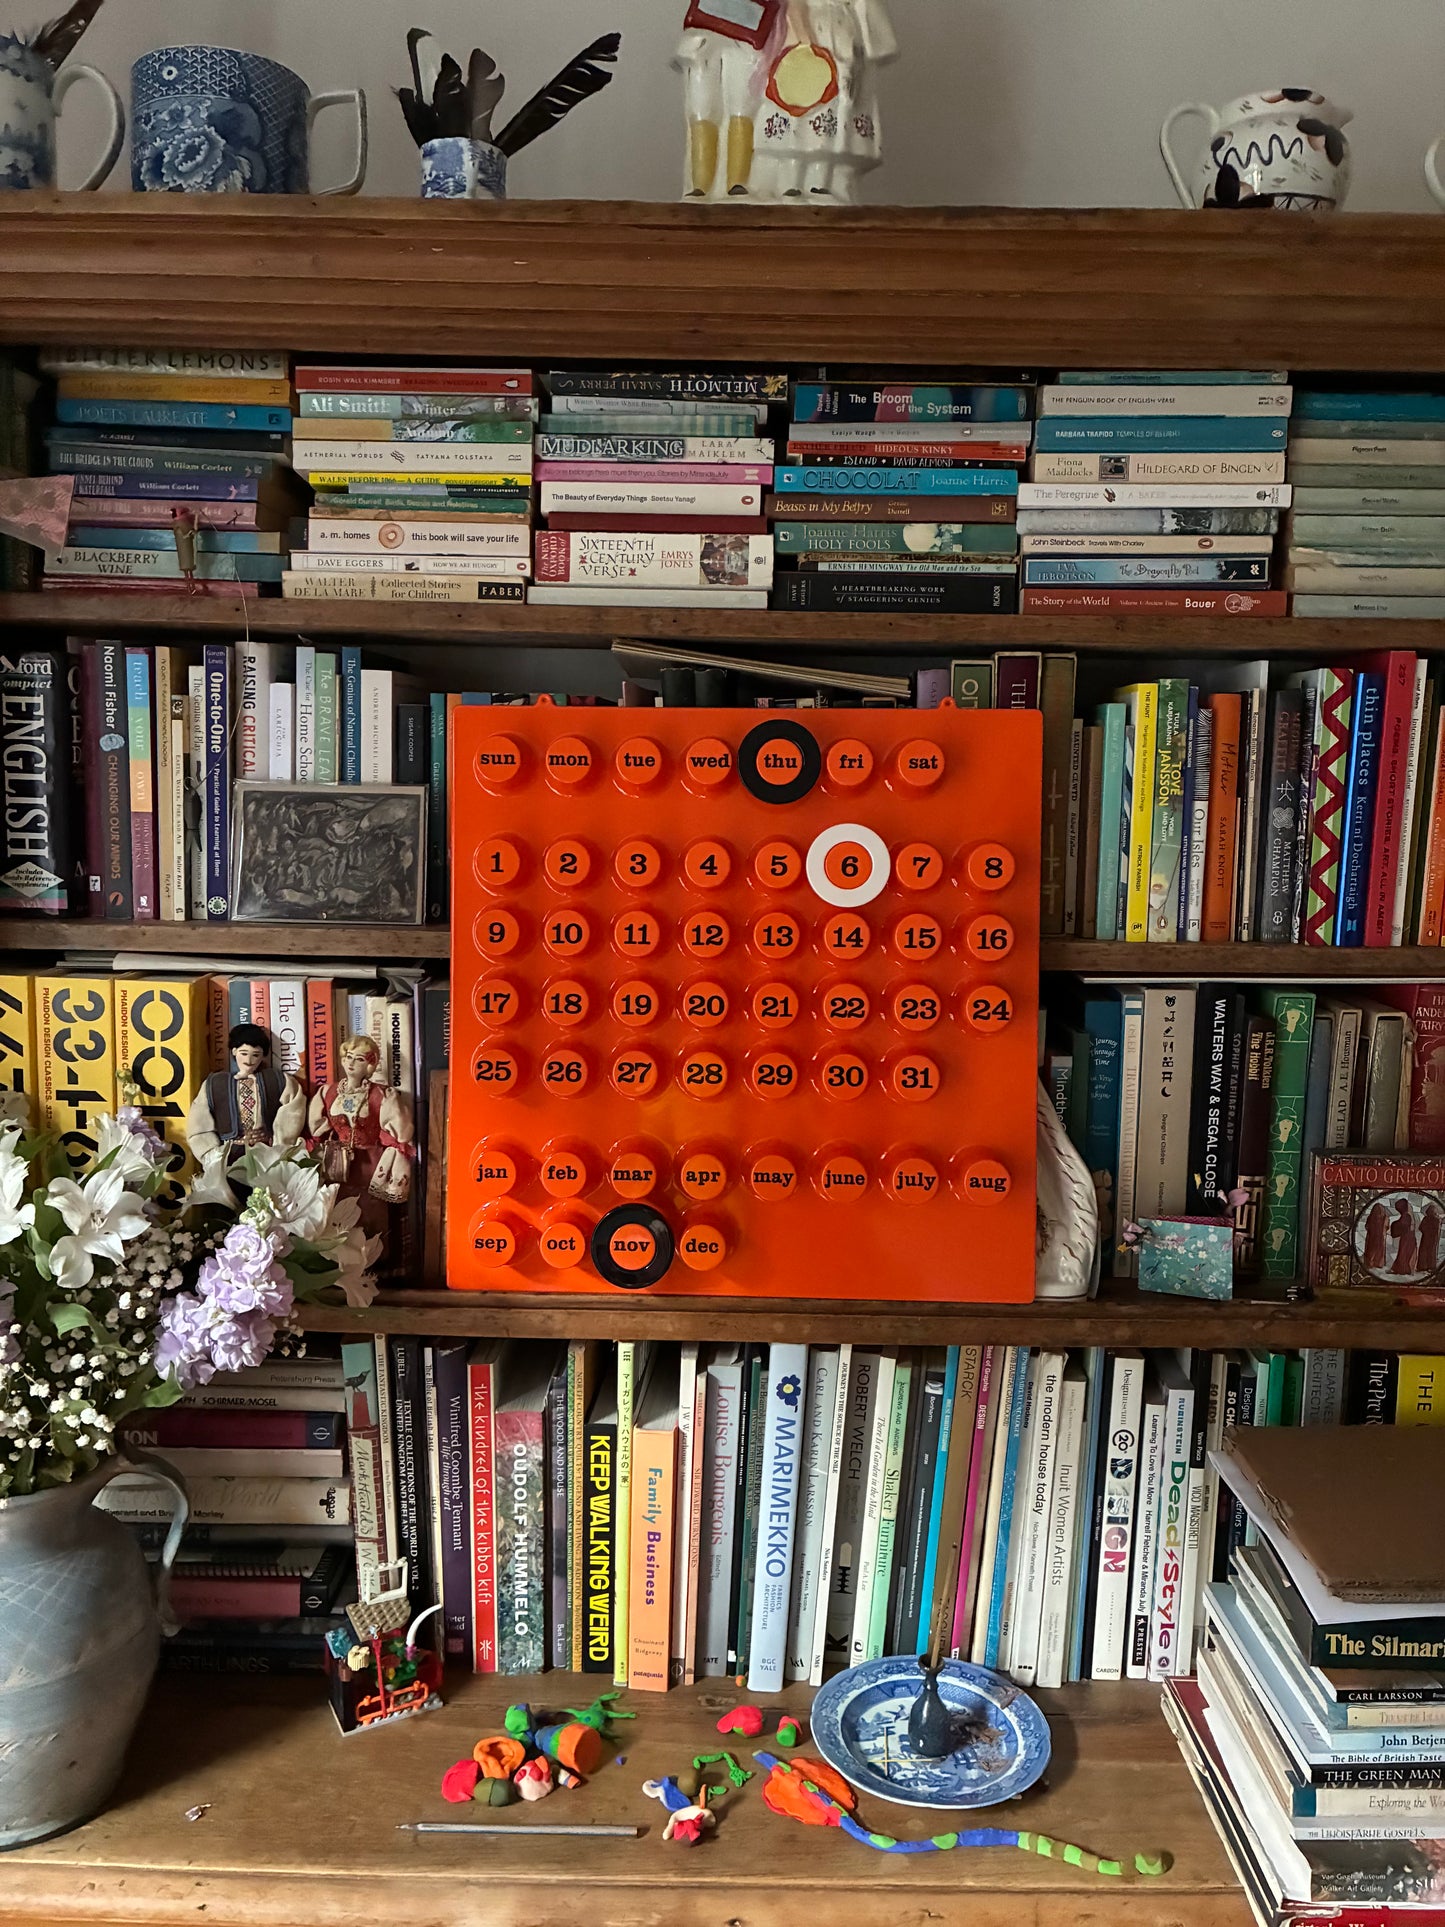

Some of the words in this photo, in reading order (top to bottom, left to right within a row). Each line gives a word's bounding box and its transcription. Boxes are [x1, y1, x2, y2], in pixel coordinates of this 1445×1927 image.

[168, 354, 270, 370] LEMONS
[670, 380, 758, 393] MELMOTH
[850, 394, 867, 404] The
[873, 392, 913, 404] Broom
[310, 398, 333, 412] Ali
[339, 398, 392, 413] Smith
[896, 403, 905, 413] of
[908, 404, 923, 413] the
[927, 403, 972, 416] System
[542, 436, 684, 456] MUDLARKING
[803, 470, 920, 490] CHOCOLAT
[932, 474, 969, 487] Joanne
[973, 475, 1009, 486] Harris
[1136, 464, 1199, 474] HILDEGARD
[1203, 464, 1218, 474] OF
[1220, 464, 1261, 474] BINGEN
[564, 494, 587, 502] Beauty
[343, 531, 370, 539] homes
[429, 533, 448, 541] book
[450, 533, 464, 541] will
[486, 536, 504, 544] your
[506, 534, 519, 543] life
[579, 536, 654, 551] SIXTEENTH
[74, 552, 159, 564] BLACKBERRY
[98, 564, 132, 574] WINE
[317, 559, 341, 567] DAVE
[345, 559, 384, 567] EGGERS
[590, 552, 654, 567] CENTURY
[660, 551, 693, 560] EMRYS
[660, 560, 693, 568] JONES
[579, 566, 626, 578] VERSE
[482, 587, 522, 597] FABER
[1030, 597, 1042, 605] The
[1043, 597, 1065, 607] Story
[1082, 596, 1110, 606] World
[1185, 598, 1216, 609] Bauer
[104, 646, 116, 687] Naomi
[321, 668, 332, 687] The
[244, 656, 256, 710] RAISING
[106, 690, 116, 729] Fisher
[210, 672, 224, 754] One-to-One
[320, 696, 331, 743] BRAVE
[1364, 688, 1380, 724] thin
[300, 704, 312, 744] Home
[242, 716, 255, 775] CRITICAL
[480, 752, 516, 766] sun
[548, 754, 590, 767] mon
[624, 752, 655, 767] tue
[690, 753, 730, 768] wed
[763, 753, 798, 769] thu
[839, 755, 864, 769] fri
[909, 755, 938, 770] sat
[1358, 731, 1373, 785] places
[2, 693, 49, 859] ENGLISH
[107, 754, 119, 814] CHANGING
[1158, 749, 1171, 807] JANSSON
[1170, 761, 1182, 796] TOVE
[1221, 742, 1236, 796] Mother
[109, 817, 120, 842] OUR
[111, 844, 121, 879] MINDS
[490, 852, 504, 873] 1
[560, 853, 578, 874] 2
[630, 853, 647, 874] 3
[700, 854, 718, 875] 4
[770, 855, 788, 877] 5
[841, 856, 858, 877] 6
[913, 856, 931, 878] 7
[985, 857, 1003, 878] 8
[1217, 854, 1225, 888] KNOTT
[488, 922, 505, 943] 9
[552, 923, 583, 944] 10
[624, 924, 651, 945] 11
[691, 924, 724, 946] 12
[762, 926, 794, 947] 13
[833, 926, 864, 948] 14
[904, 928, 936, 949] 15
[977, 928, 1008, 950] 16
[279, 992, 295, 1022] The
[314, 1001, 326, 1028] ALL
[480, 992, 510, 1014] 17
[550, 993, 582, 1014] 18
[620, 994, 652, 1016] 19
[688, 995, 725, 1016] 20
[761, 996, 793, 1018] 21
[830, 997, 865, 1018] 22
[900, 998, 937, 1020] 23
[972, 999, 1010, 1020] 24
[1212, 999, 1226, 1064] WALTERS
[1254, 1032, 1263, 1049] The
[314, 1032, 327, 1072] YEAR
[392, 1013, 401, 1087] HOUSEBUILDING
[476, 1060, 512, 1081] 25
[546, 1061, 582, 1082] 26
[617, 1062, 652, 1084] 27
[686, 1064, 723, 1085] 28
[757, 1064, 793, 1086] 29
[828, 1066, 864, 1087] 30
[901, 1067, 933, 1089] 31
[1210, 1066, 1223, 1094] WAY
[1248, 1052, 1260, 1081] Hobbit
[1210, 1096, 1221, 1106] &
[1207, 1108, 1220, 1152] SEGAL
[476, 1164, 508, 1183] jan
[547, 1166, 578, 1180] feb
[613, 1170, 653, 1182] mar
[686, 1171, 720, 1186] apr
[753, 1172, 794, 1187] may
[824, 1170, 865, 1188] june
[896, 1171, 936, 1190] july
[969, 1176, 1006, 1192] aug
[1204, 1154, 1216, 1199] CLOSE
[1323, 1167, 1378, 1183] CANTO
[474, 1237, 508, 1253] sep
[547, 1237, 576, 1251] oct
[614, 1241, 650, 1253] nov
[685, 1239, 719, 1254] dec
[854, 1364, 871, 1421] ROBERT
[1046, 1374, 1057, 1393] the
[450, 1396, 461, 1447] Winifred
[716, 1385, 736, 1446] Louise
[1042, 1397, 1053, 1440] modern
[590, 1435, 611, 1491] KEEP
[848, 1426, 865, 1480] WELCH
[1038, 1444, 1050, 1479] house
[451, 1451, 462, 1499] Coombe
[513, 1443, 527, 1526] OUDOLF
[1060, 1464, 1072, 1491] Inuit
[648, 1468, 663, 1524] Family
[710, 1454, 732, 1545] Bourgeois
[765, 1416, 797, 1578] MARIMEKKO
[1033, 1481, 1047, 1516] today
[1166, 1461, 1187, 1547] Dead
[452, 1503, 463, 1552] Tennant
[1056, 1493, 1071, 1544] Women
[477, 1532, 491, 1573] kibbo
[589, 1492, 610, 1590] WALKING
[645, 1531, 661, 1605] Business
[1051, 1547, 1066, 1587] Artists
[478, 1579, 493, 1604] kift
[514, 1532, 528, 1635] HUMMELO
[1157, 1557, 1180, 1649] Style
[588, 1594, 609, 1661] WEIRD
[1325, 1634, 1365, 1656] The
[1378, 1692, 1422, 1700] LARSSON
[1381, 1735, 1407, 1748] John
[1372, 1754, 1382, 1762] of
[1384, 1754, 1415, 1762] British
[1324, 1771, 1352, 1781] THE
[1358, 1770, 1404, 1780] GREEN
[1409, 1769, 1441, 1779] MAN
